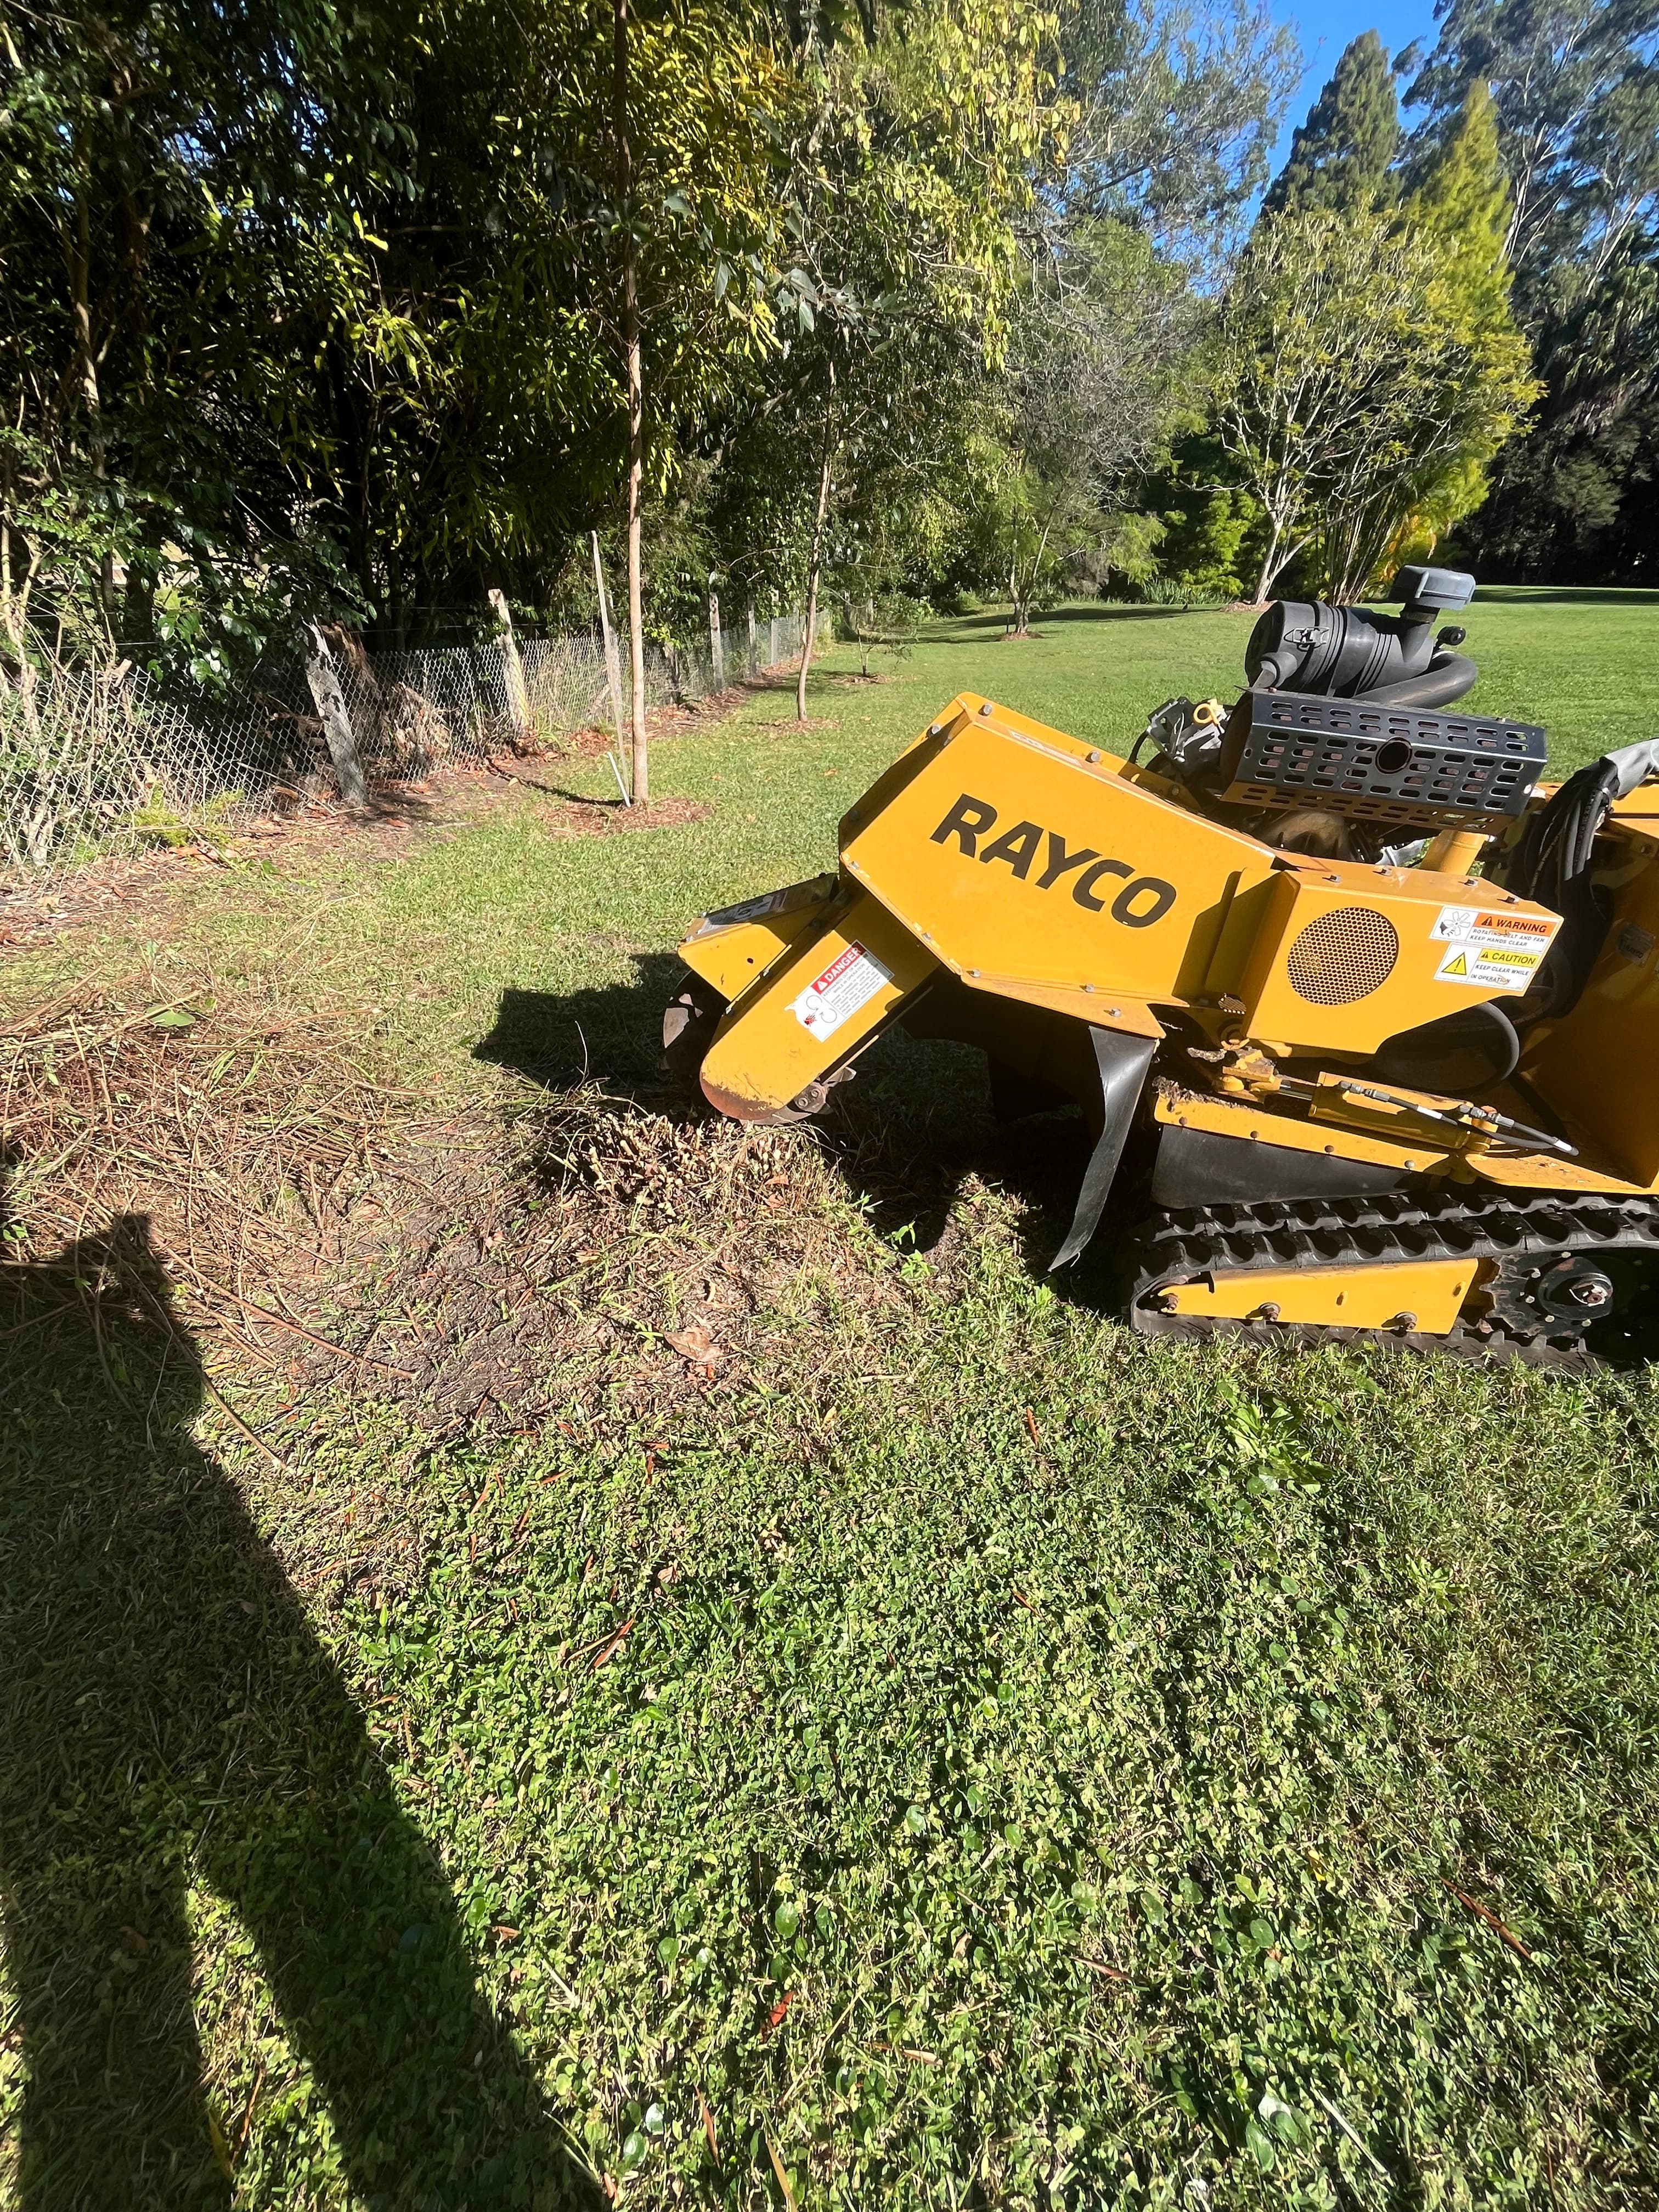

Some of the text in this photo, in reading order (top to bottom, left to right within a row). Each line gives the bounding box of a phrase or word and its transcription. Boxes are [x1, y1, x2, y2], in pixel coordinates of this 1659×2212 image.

[929, 793, 1176, 928] RAYCO
[1497, 919, 1547, 933] WARNING
[824, 947, 861, 983] DANGER
[1492, 952, 1536, 964] CAUTION
